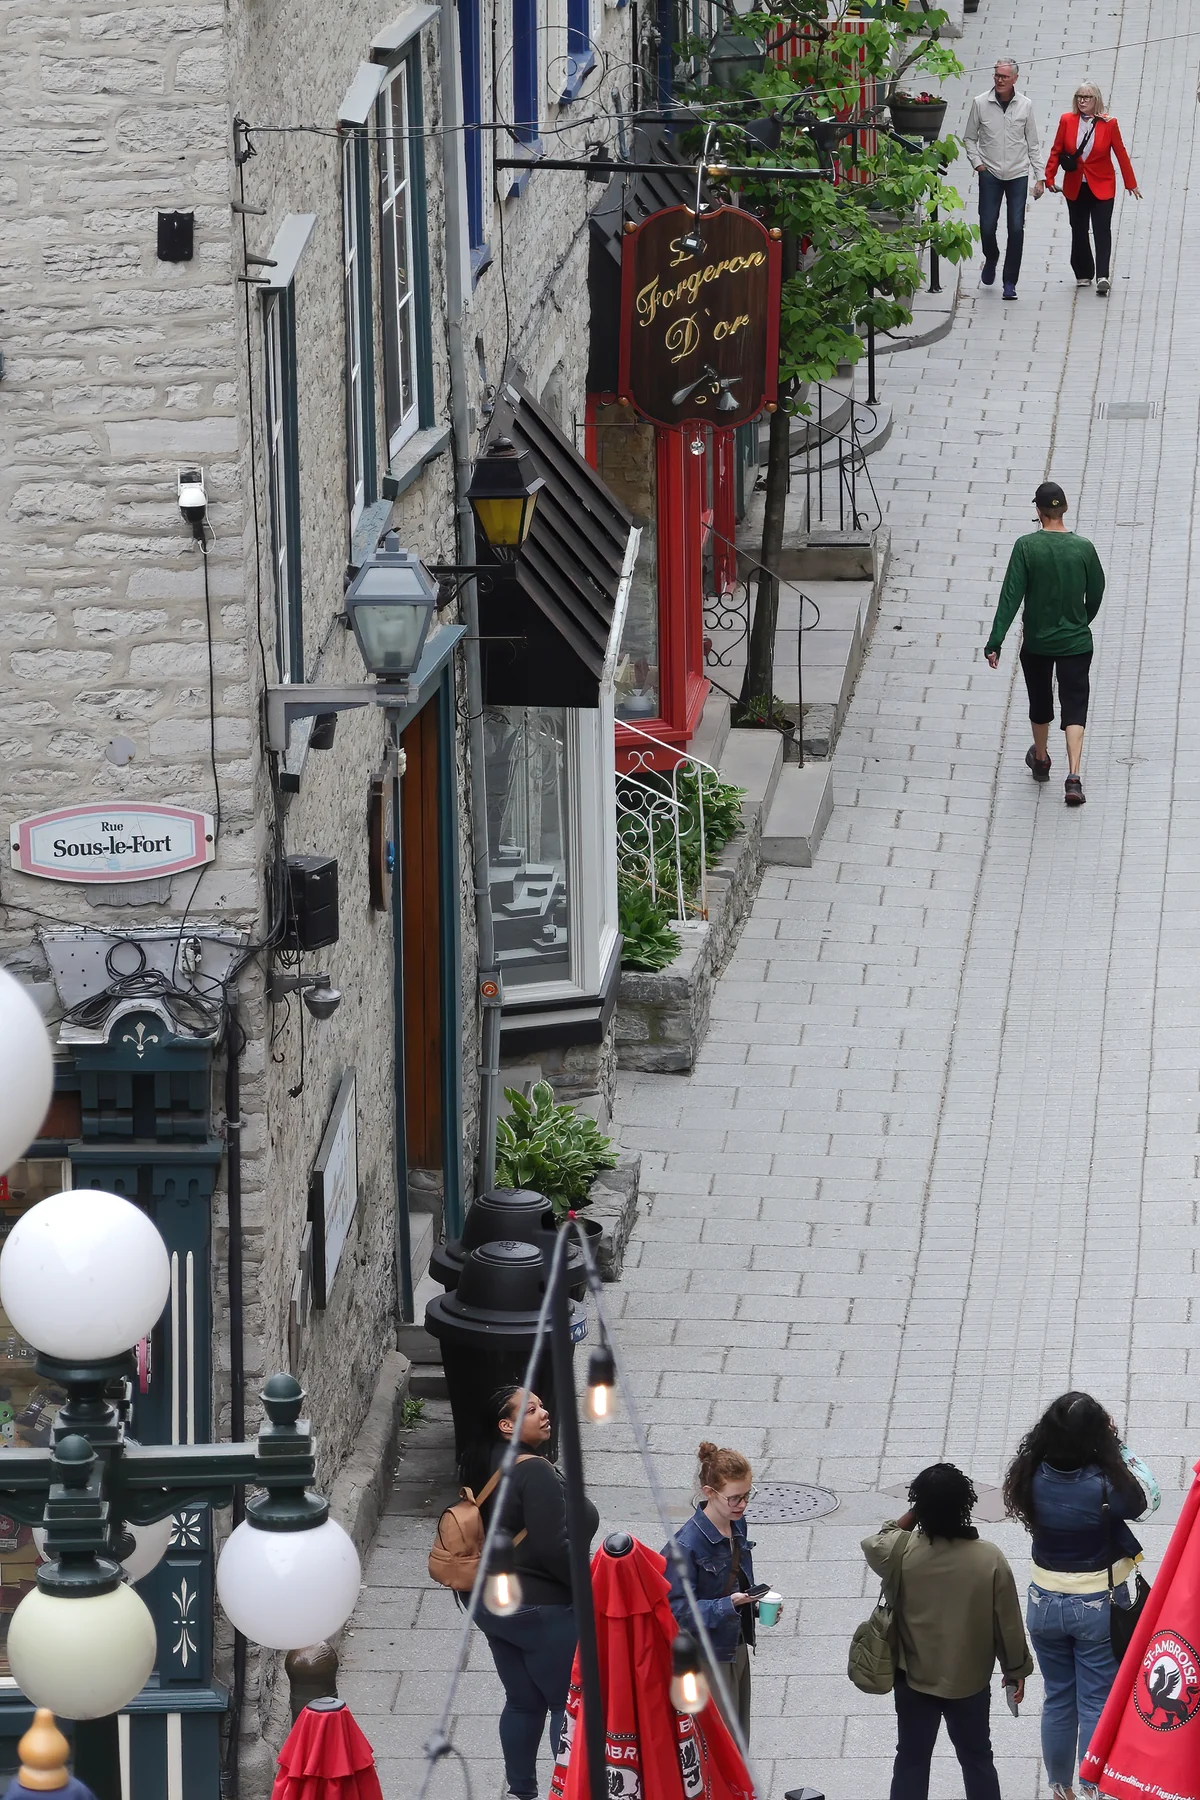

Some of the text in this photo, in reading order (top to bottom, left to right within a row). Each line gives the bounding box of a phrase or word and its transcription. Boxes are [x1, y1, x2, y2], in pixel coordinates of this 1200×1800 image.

[636, 251, 767, 327] Forgeron
[101, 821, 124, 832] Rue
[53, 834, 172, 858] Sous-le-Fort
[1143, 1640, 1198, 1685] ST-AMBROISE
